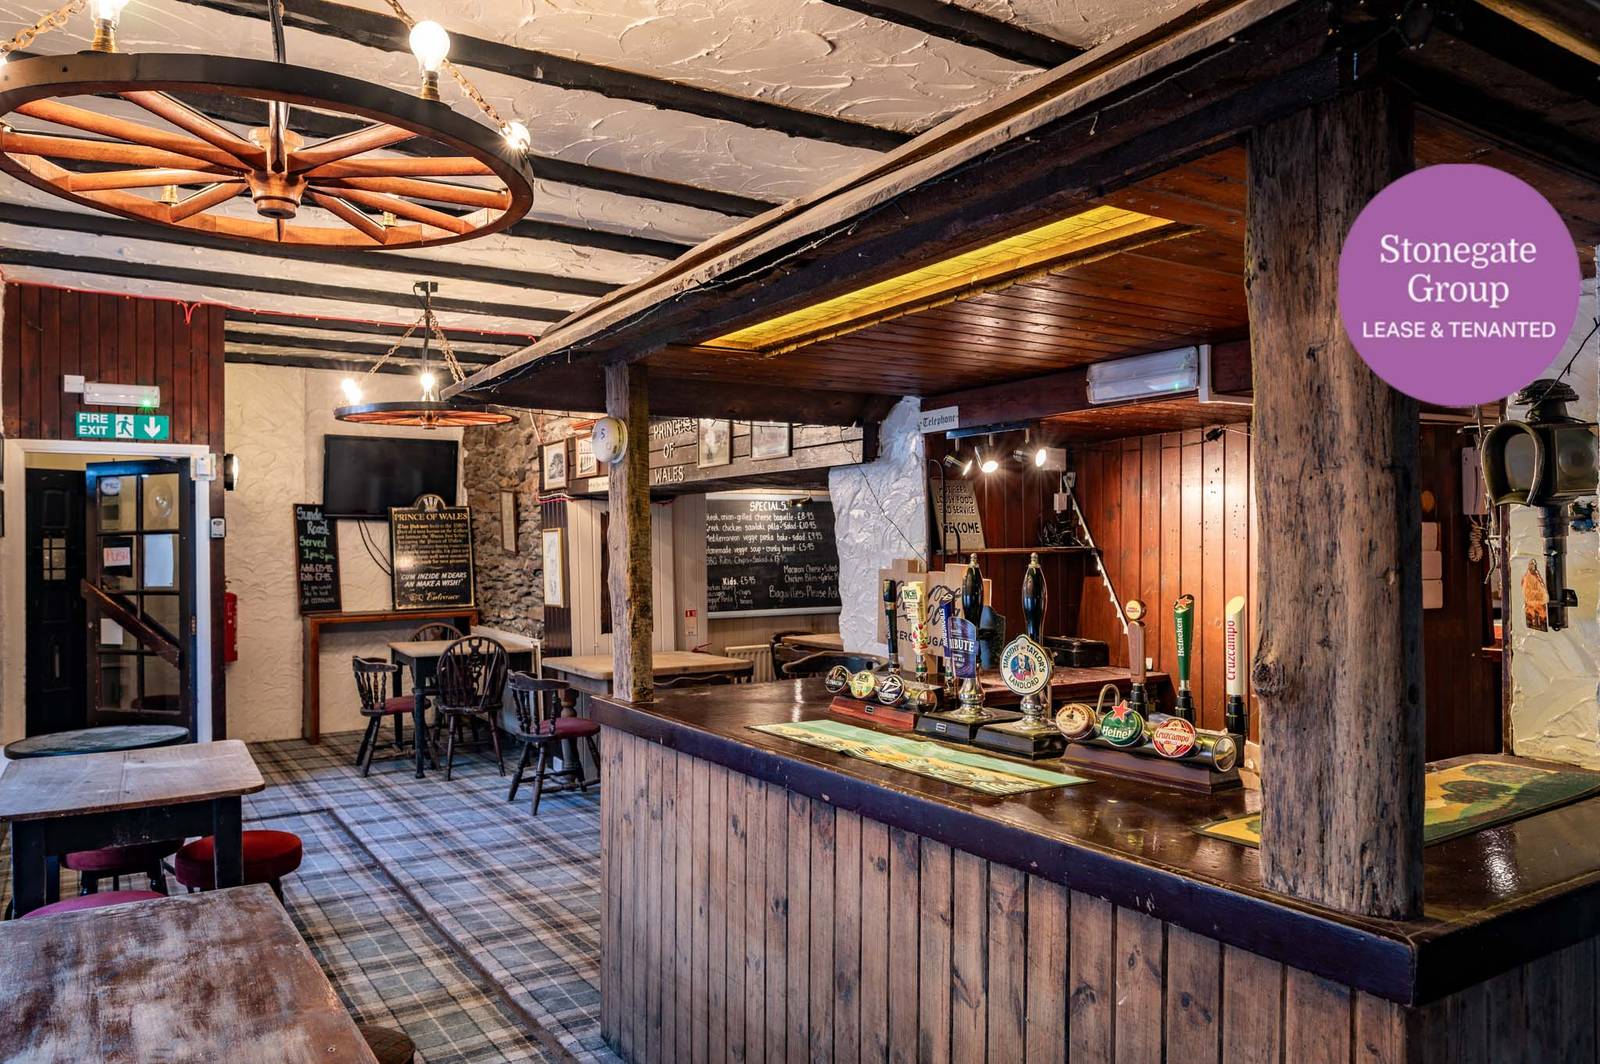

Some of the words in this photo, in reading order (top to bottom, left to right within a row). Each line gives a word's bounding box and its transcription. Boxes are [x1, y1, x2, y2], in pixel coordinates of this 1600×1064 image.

[79, 413, 109, 424] FIRE
[923, 414, 956, 428] Telephone
[79, 425, 109, 436] EXIT
[653, 418, 699, 440] PRINCESS
[663, 443, 677, 460] OF
[654, 466, 685, 484] WALES
[394, 512, 425, 521] PRINCE
[426, 512, 438, 521] OF
[439, 512, 468, 521] WALES
[299, 535, 327, 548] Served
[416, 579, 434, 587] MAKE
[1175, 617, 1185, 657] Heineken
[1227, 620, 1238, 681] Cruzcampo
[1003, 644, 1020, 669] TIMOTHY
[1026, 644, 1047, 673] TAYLOR'S
[1008, 676, 1040, 690] LANDLORD
